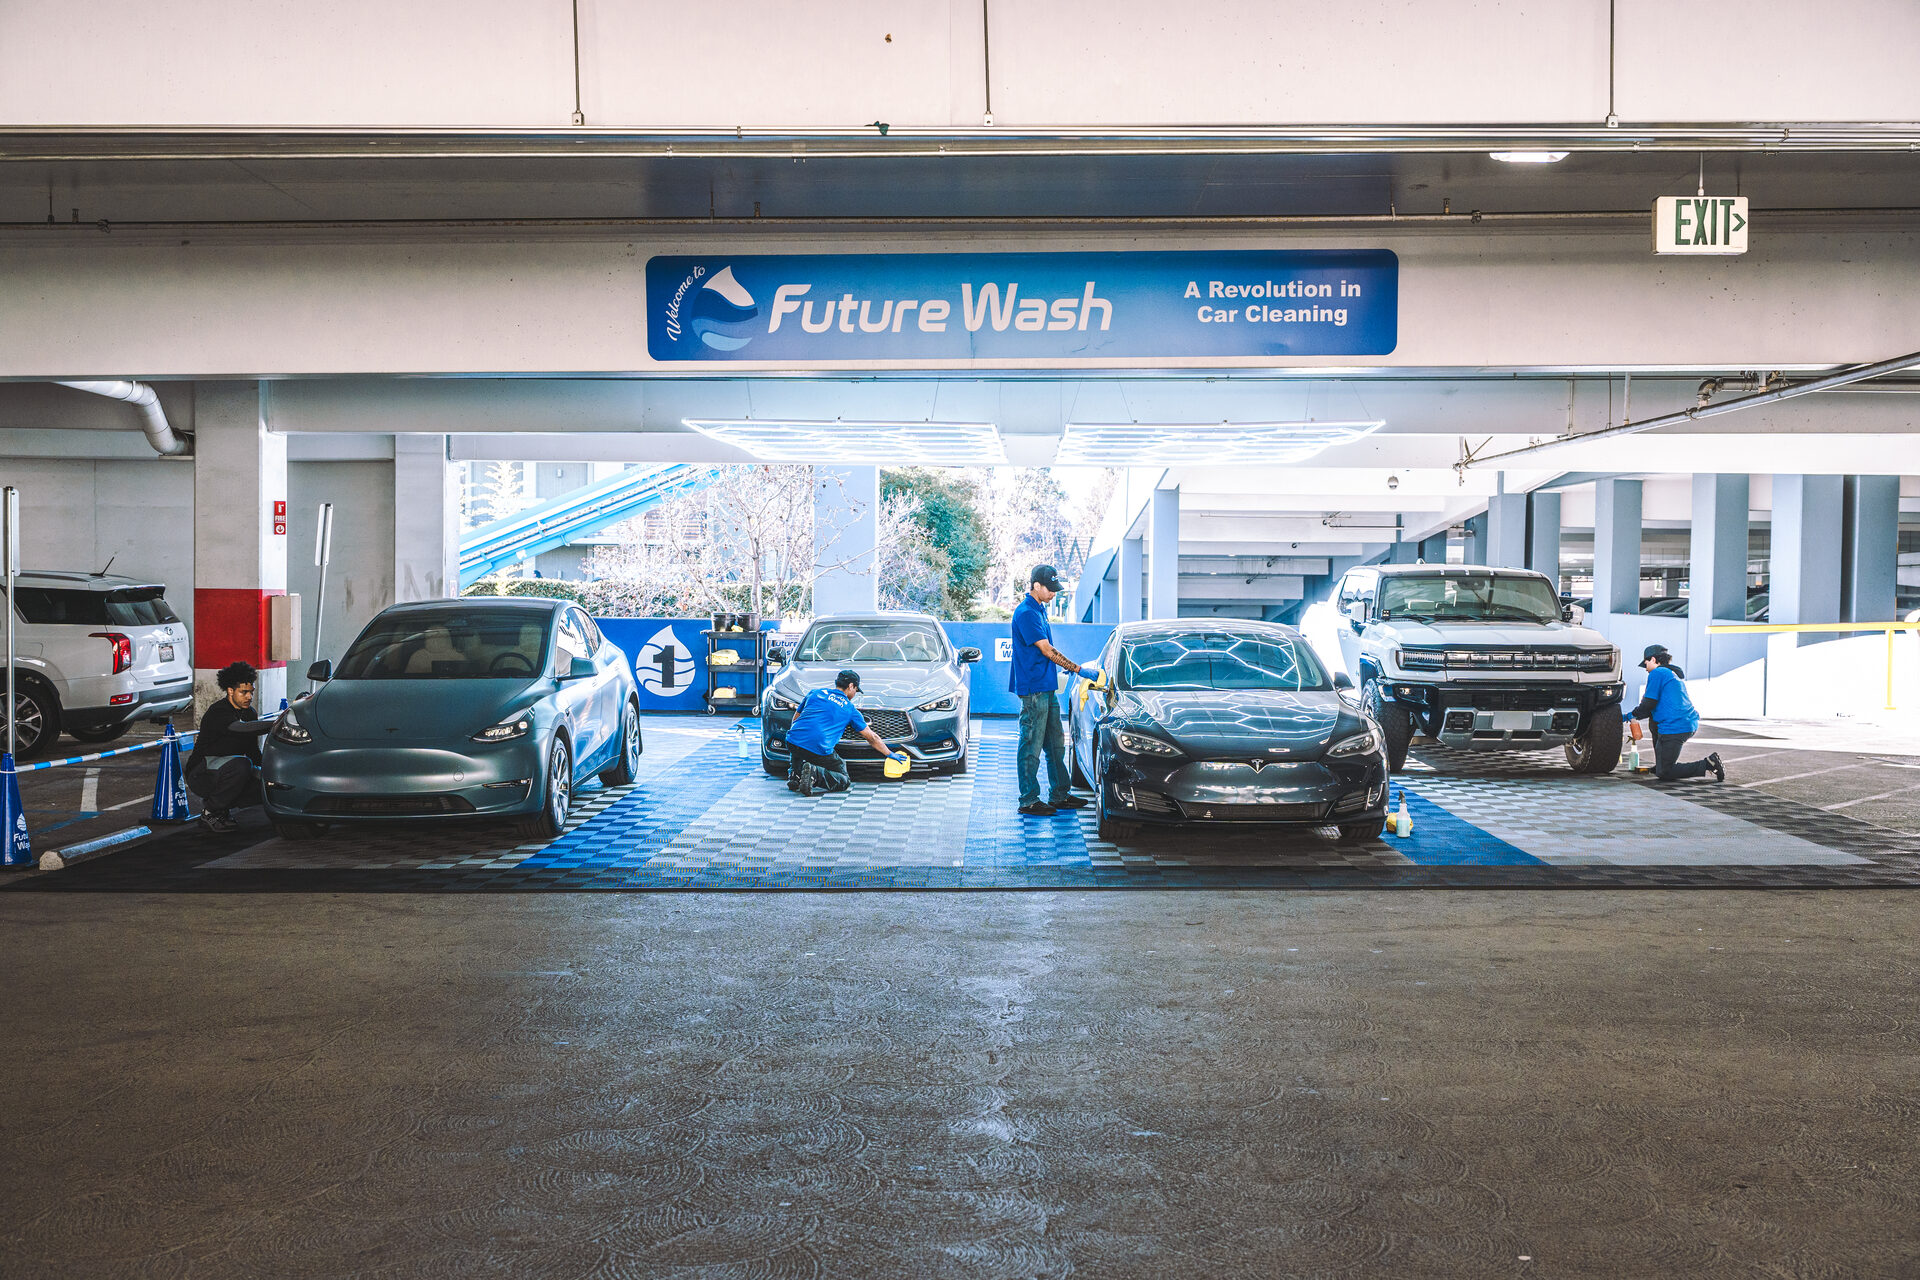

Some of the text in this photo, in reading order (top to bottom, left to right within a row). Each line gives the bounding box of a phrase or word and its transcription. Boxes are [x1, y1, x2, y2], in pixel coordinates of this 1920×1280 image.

[1675, 199, 1735, 245] EXIT
[666, 265, 706, 341] Welcome to
[768, 281, 1113, 333] Future Wash
[1183, 280, 1361, 298] A Revolution in
[1197, 305, 1348, 327] Car Cleaning
[653, 645, 675, 688] 1
